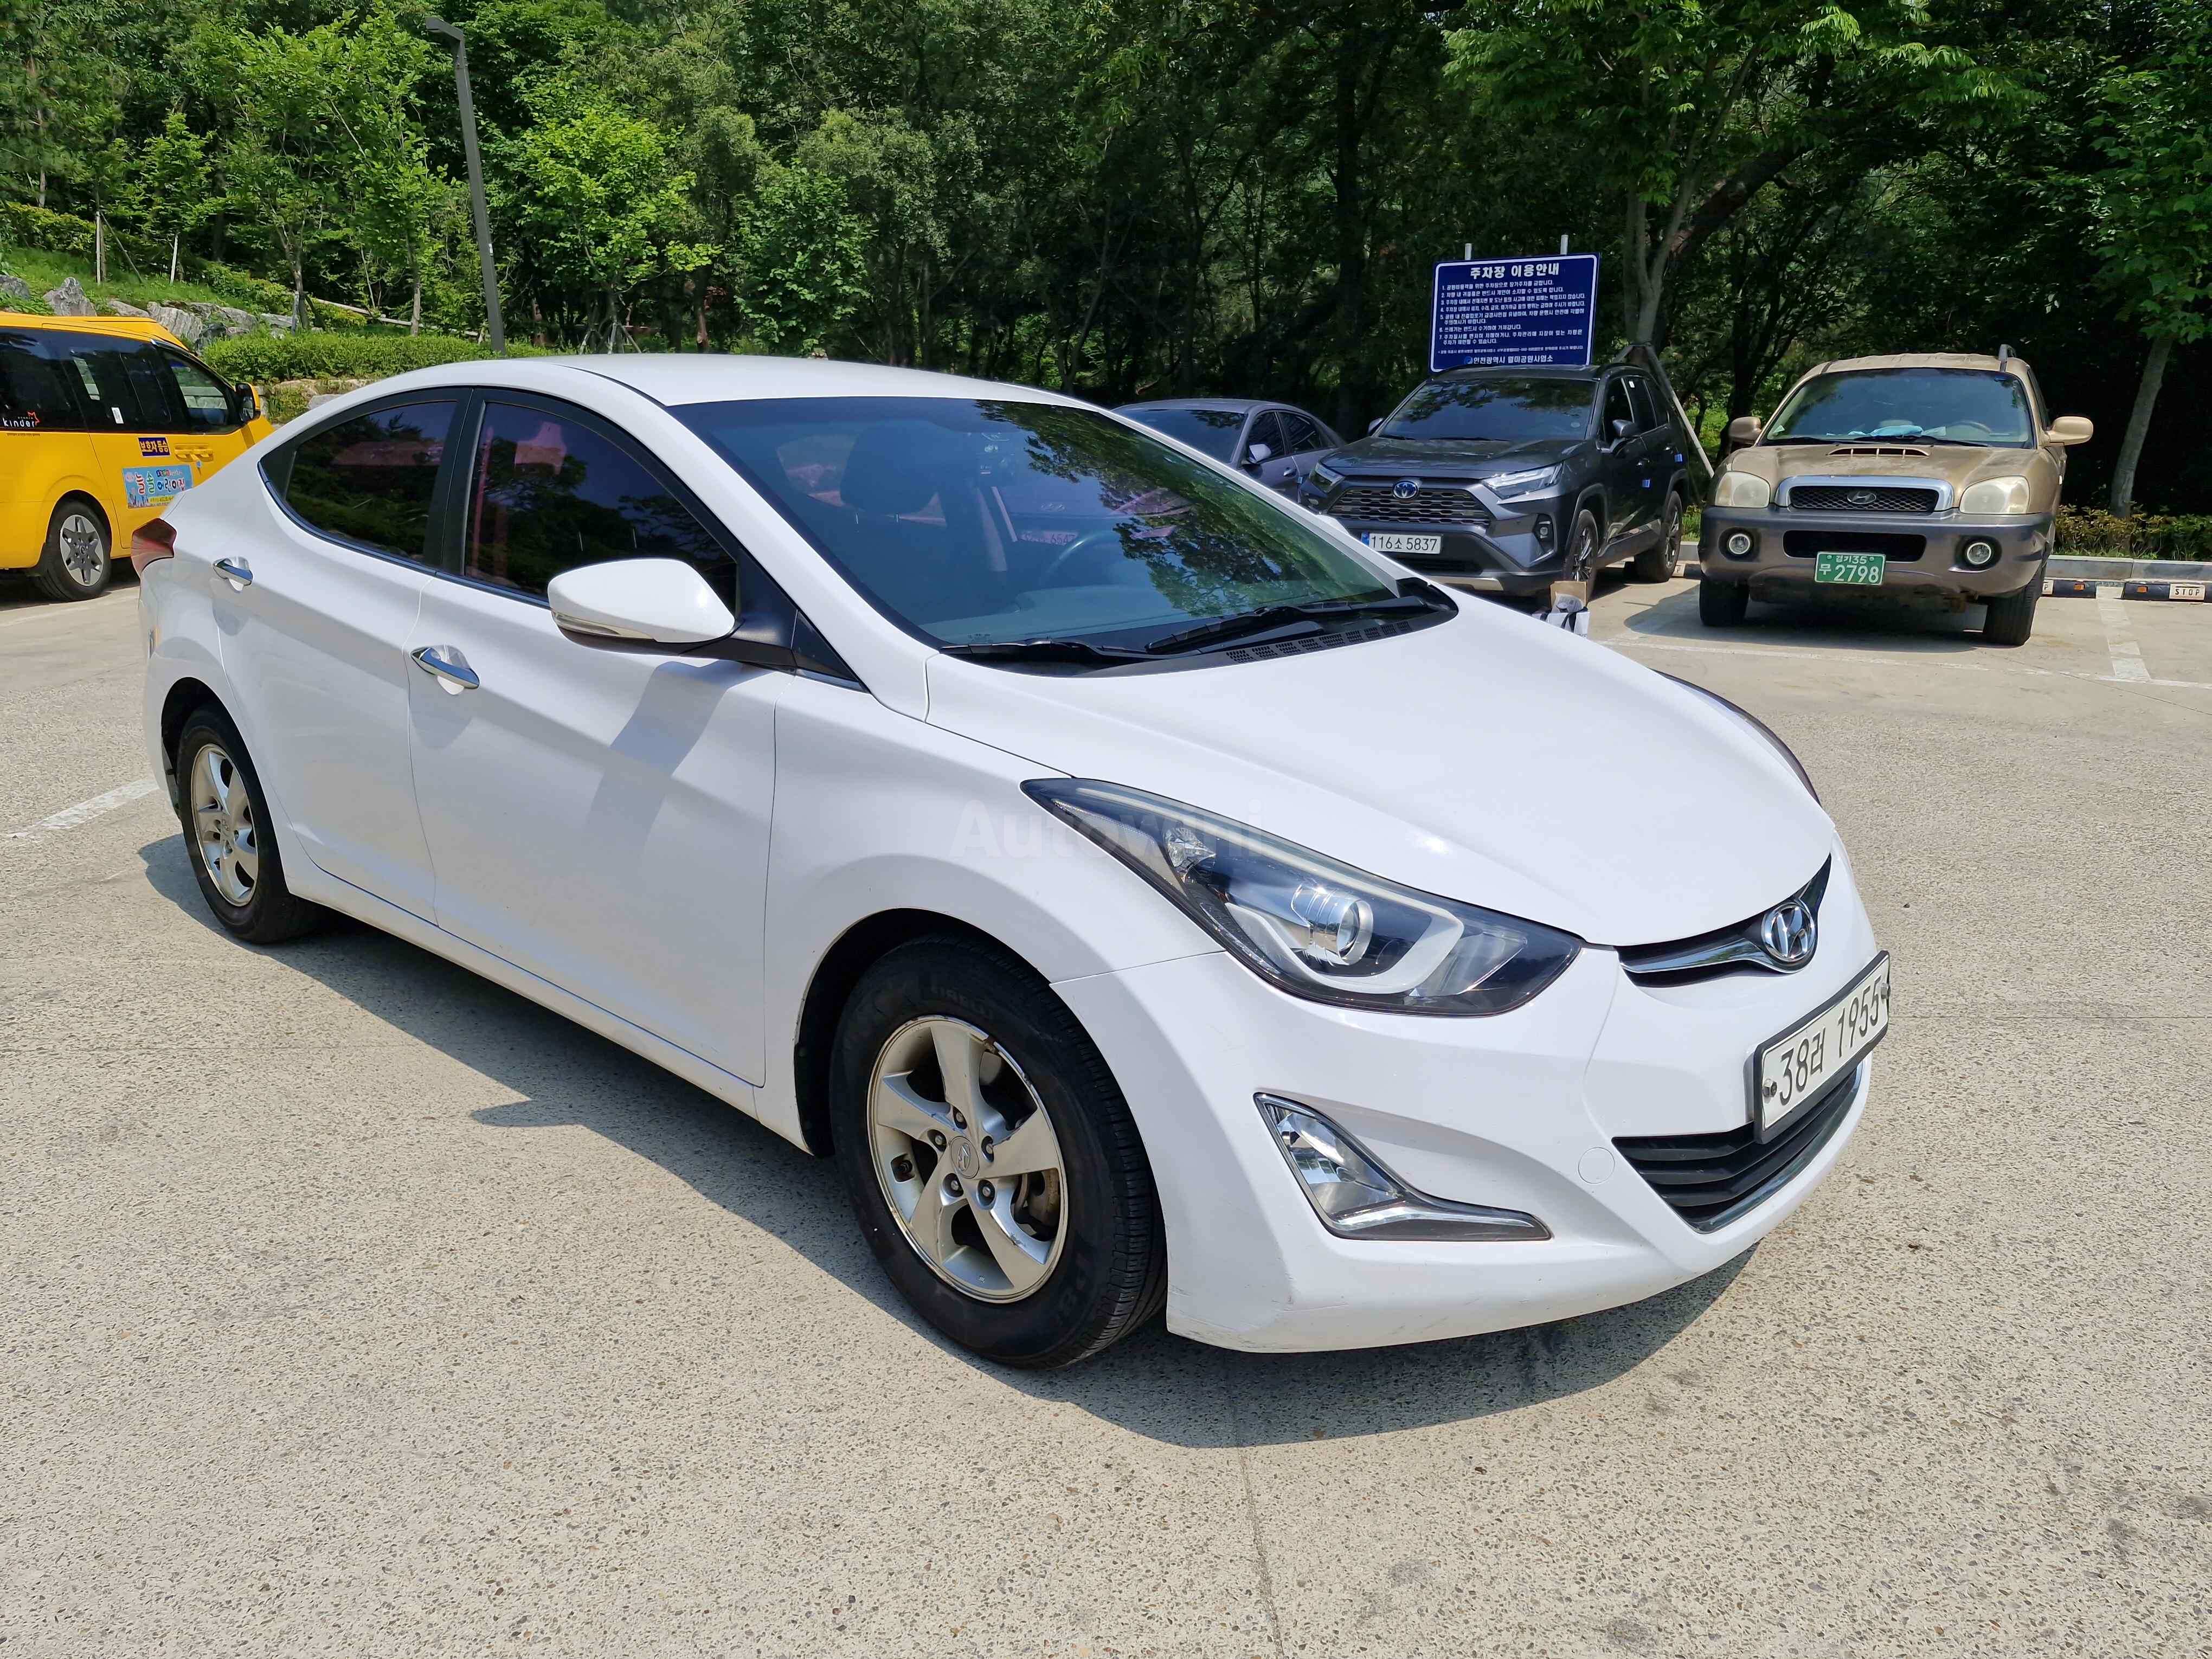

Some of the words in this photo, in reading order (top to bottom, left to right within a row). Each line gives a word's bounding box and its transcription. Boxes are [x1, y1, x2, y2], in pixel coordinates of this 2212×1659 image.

[1470, 265, 1505, 280] 주차장
[1510, 262, 1559, 278] 이용안내
[3, 417, 34, 427] kinder
[1371, 536, 1403, 550] 116소
[1406, 537, 1438, 551] 5837
[1819, 563, 1832, 575] 무
[1834, 564, 1879, 583] 2798
[2175, 588, 2200, 596] STOP
[1779, 1027, 1826, 1106] 38러
[1838, 975, 1882, 1058] 1955
